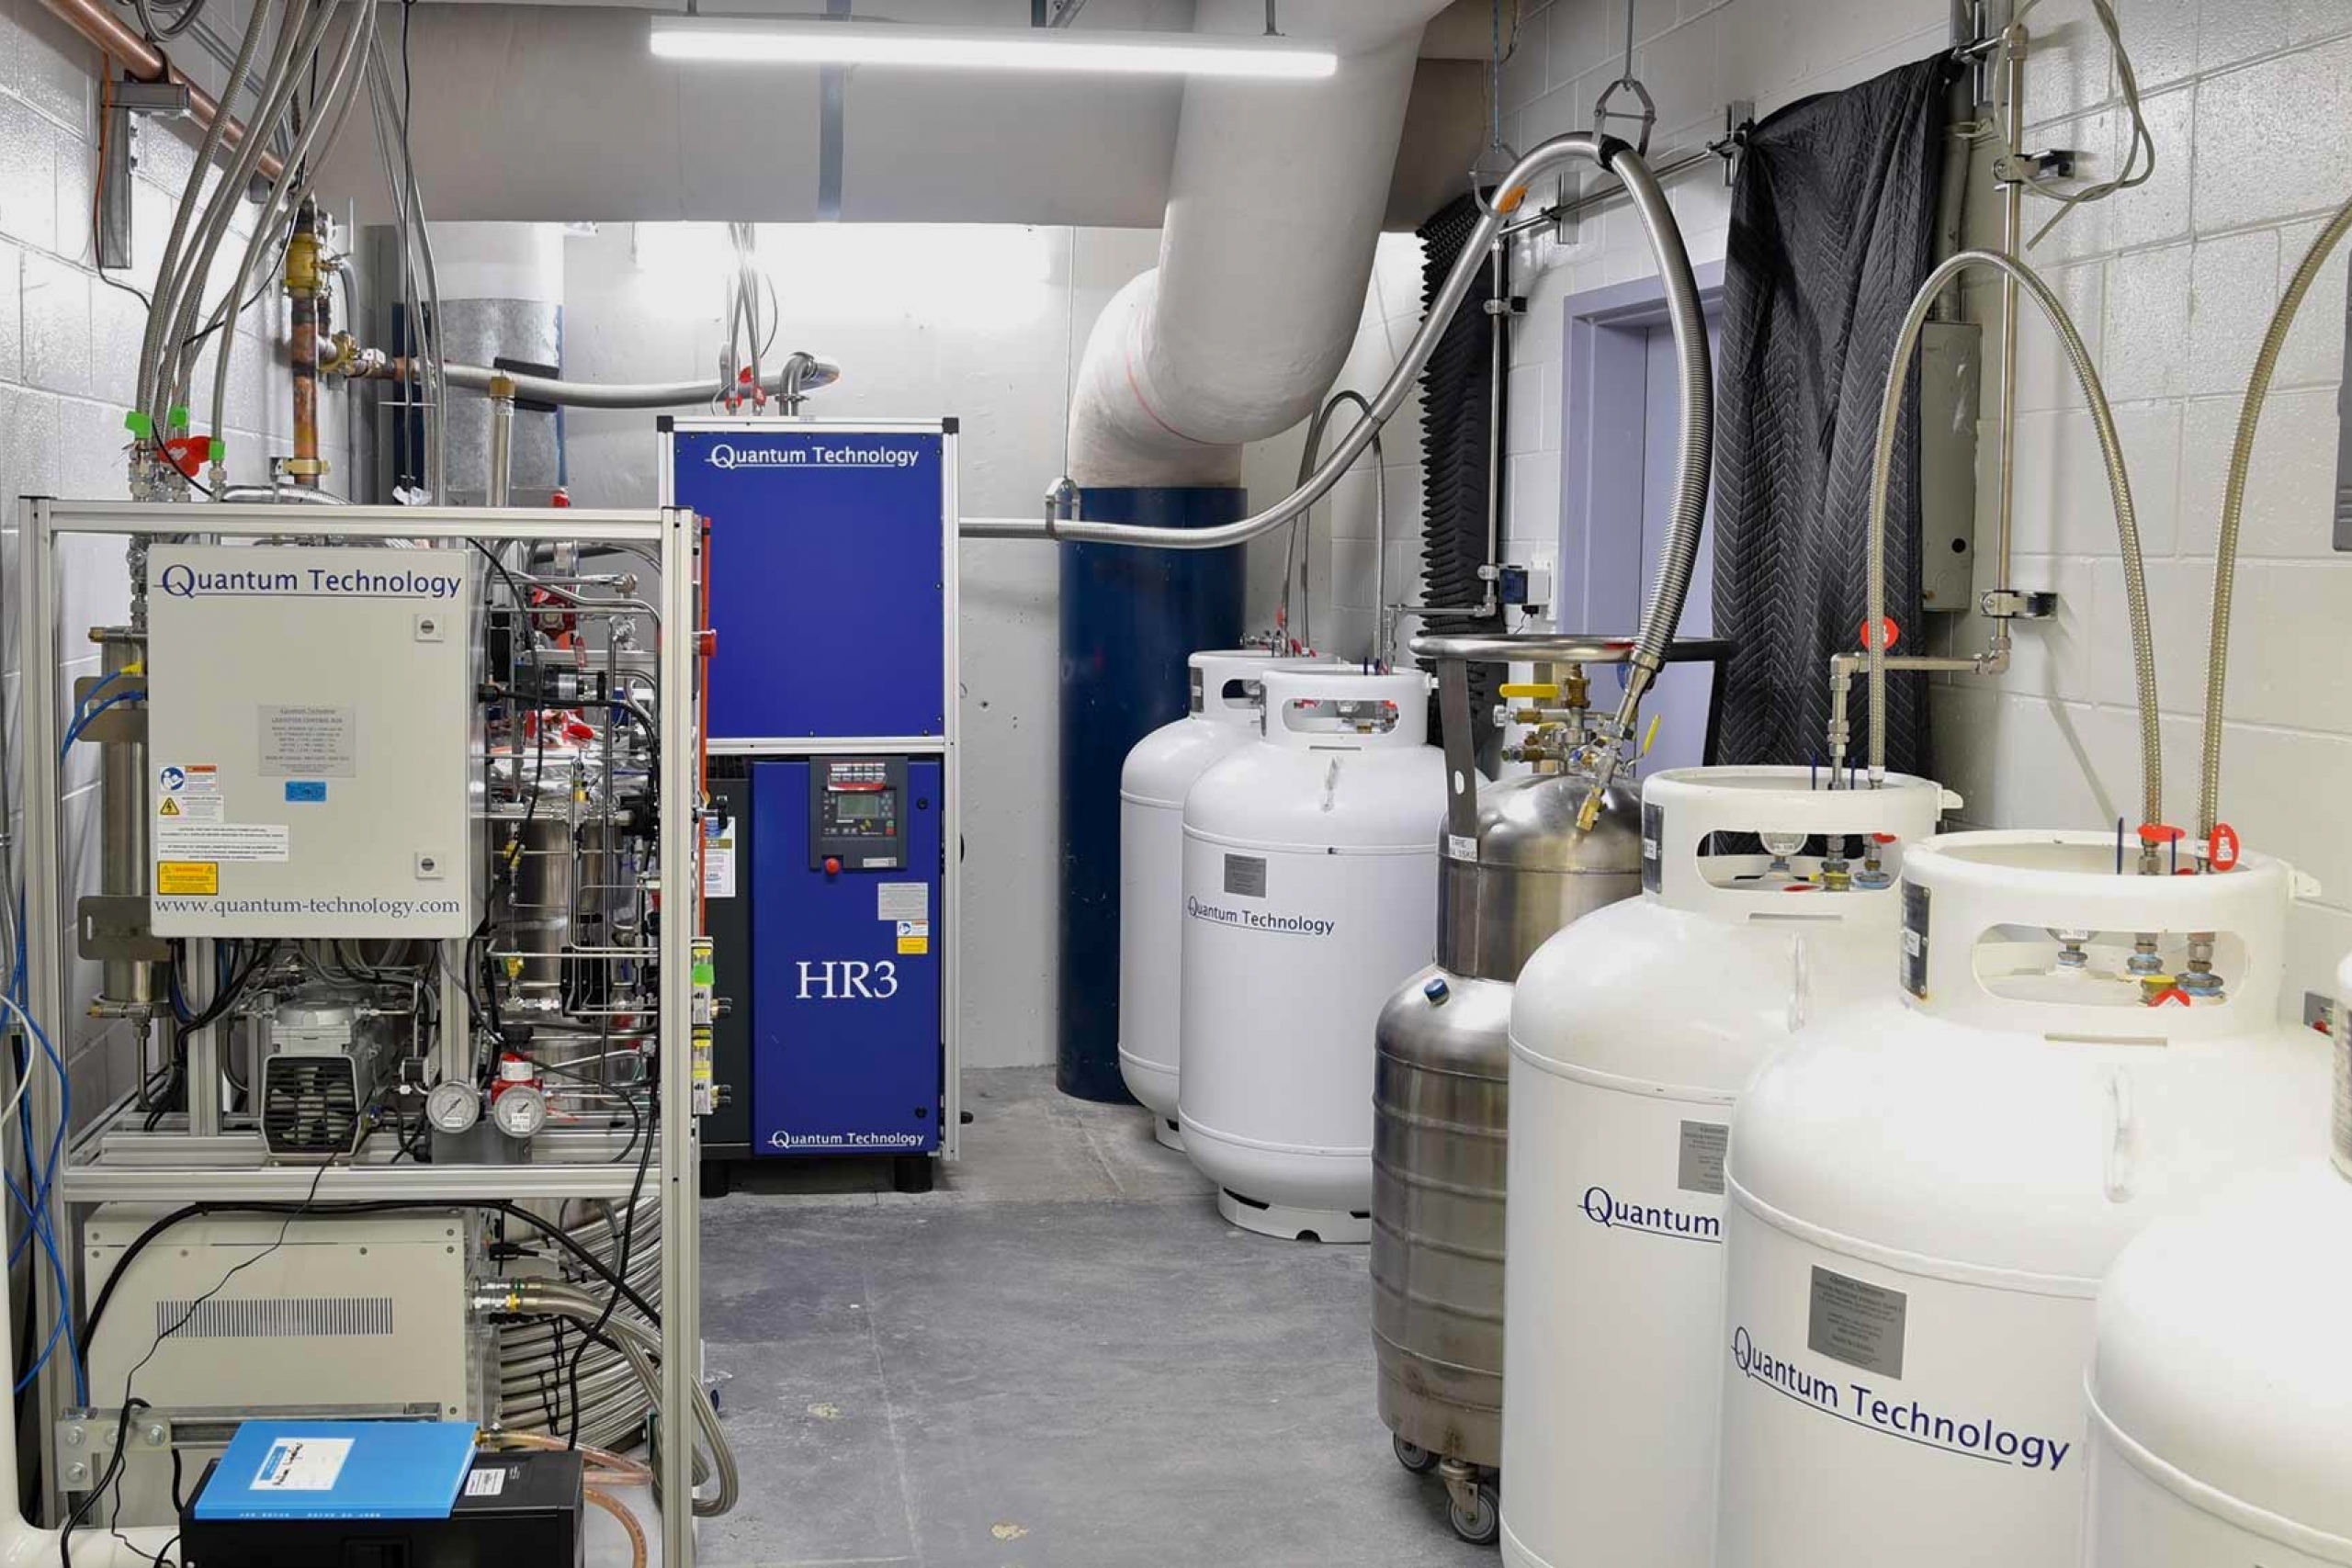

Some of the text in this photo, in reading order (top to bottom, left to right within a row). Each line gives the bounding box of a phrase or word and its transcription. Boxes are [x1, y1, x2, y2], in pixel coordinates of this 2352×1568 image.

[706, 443, 920, 469] Quantum Technology
[156, 564, 462, 599] Quantum Technology
[155, 897, 461, 919] www.quantum-technology.com
[1188, 896, 1335, 936] Quantum Technology
[796, 961, 898, 998] HR3
[768, 1130, 924, 1149] Quantum Technology
[1577, 1186, 1721, 1236] Quantum
[1731, 1325, 2072, 1472] Quantum Technology
